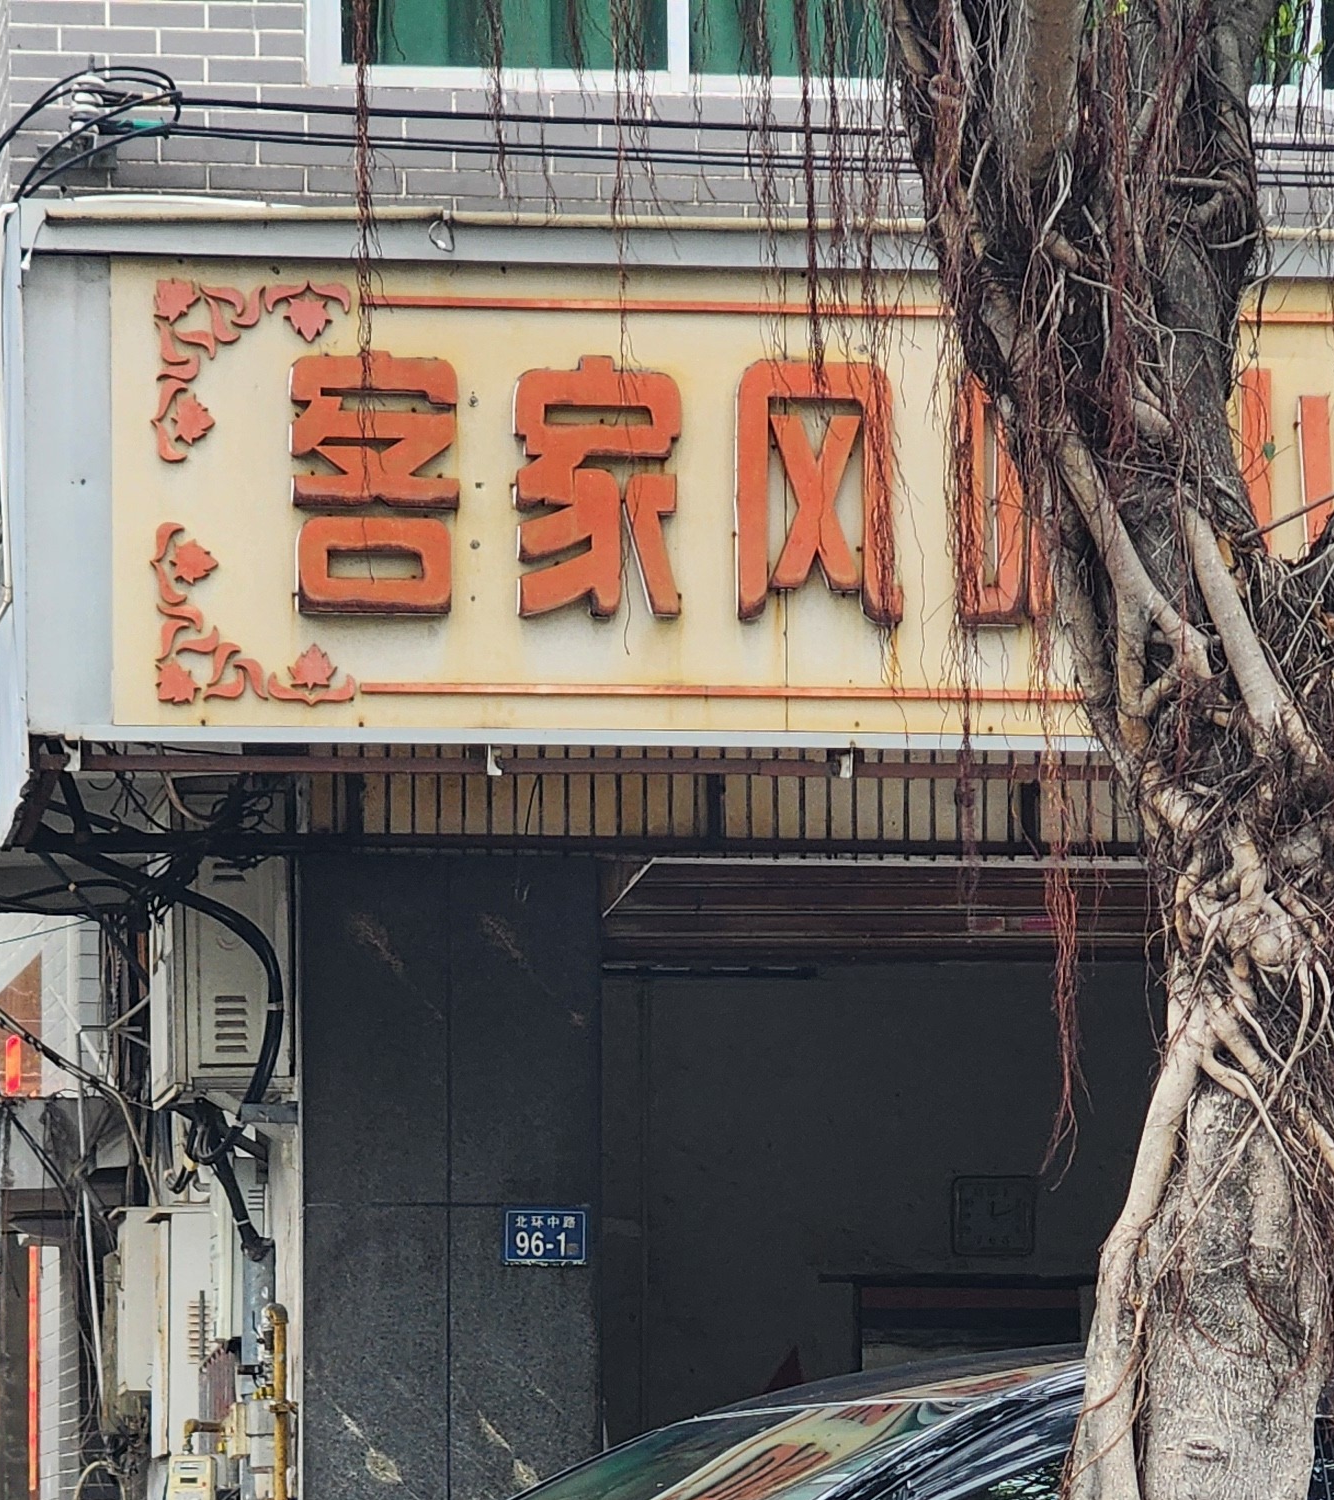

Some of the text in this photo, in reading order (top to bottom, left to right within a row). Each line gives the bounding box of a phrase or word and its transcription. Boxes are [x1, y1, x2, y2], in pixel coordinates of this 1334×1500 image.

[514, 1215, 577, 1229] 北环中路
[515, 1231, 566, 1257] 96-1
